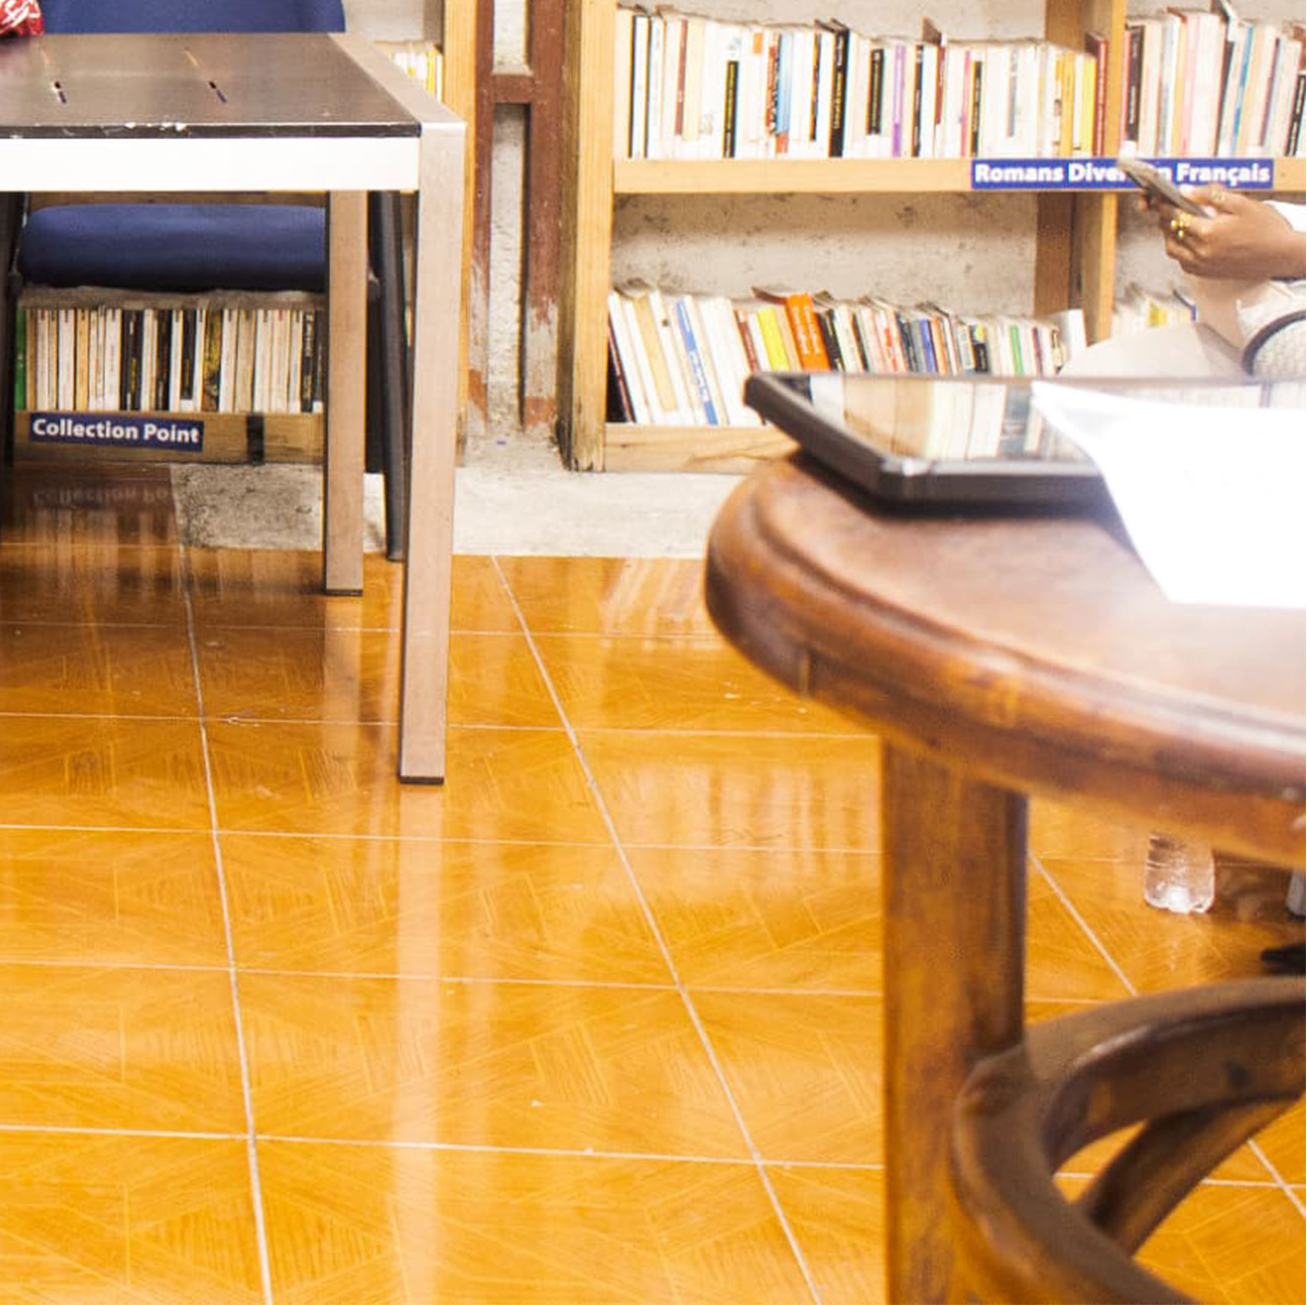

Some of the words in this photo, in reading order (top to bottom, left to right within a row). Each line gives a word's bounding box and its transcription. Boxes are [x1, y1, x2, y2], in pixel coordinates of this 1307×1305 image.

[975, 163, 1065, 183] Romans
[1175, 162, 1272, 187] Français
[32, 418, 139, 440] Collection
[143, 422, 200, 443] Point
